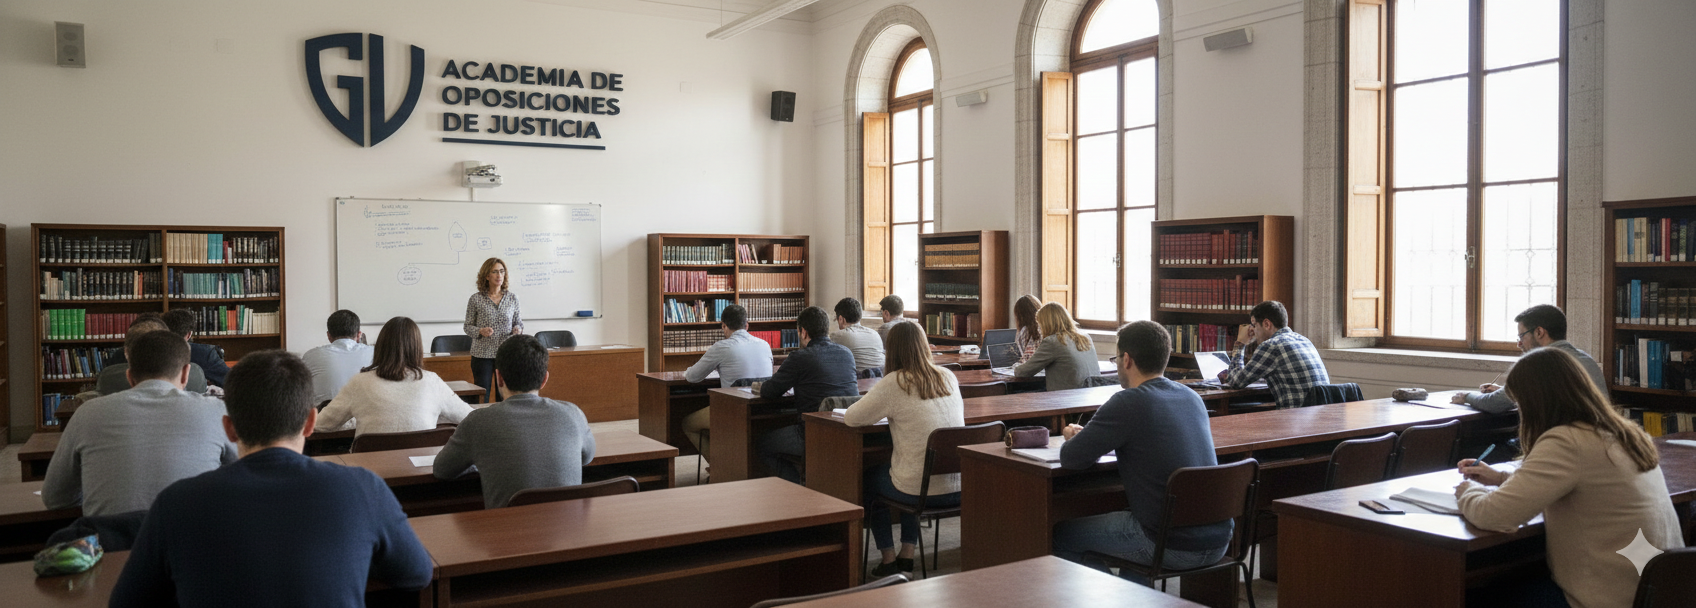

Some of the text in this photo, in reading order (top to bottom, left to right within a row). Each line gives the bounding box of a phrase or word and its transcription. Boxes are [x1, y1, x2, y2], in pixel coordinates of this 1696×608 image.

[442, 59, 624, 91] ACADEMIA DE
[442, 85, 621, 116] OPOSICIONES
[443, 112, 602, 139] DE JUSTICIA
